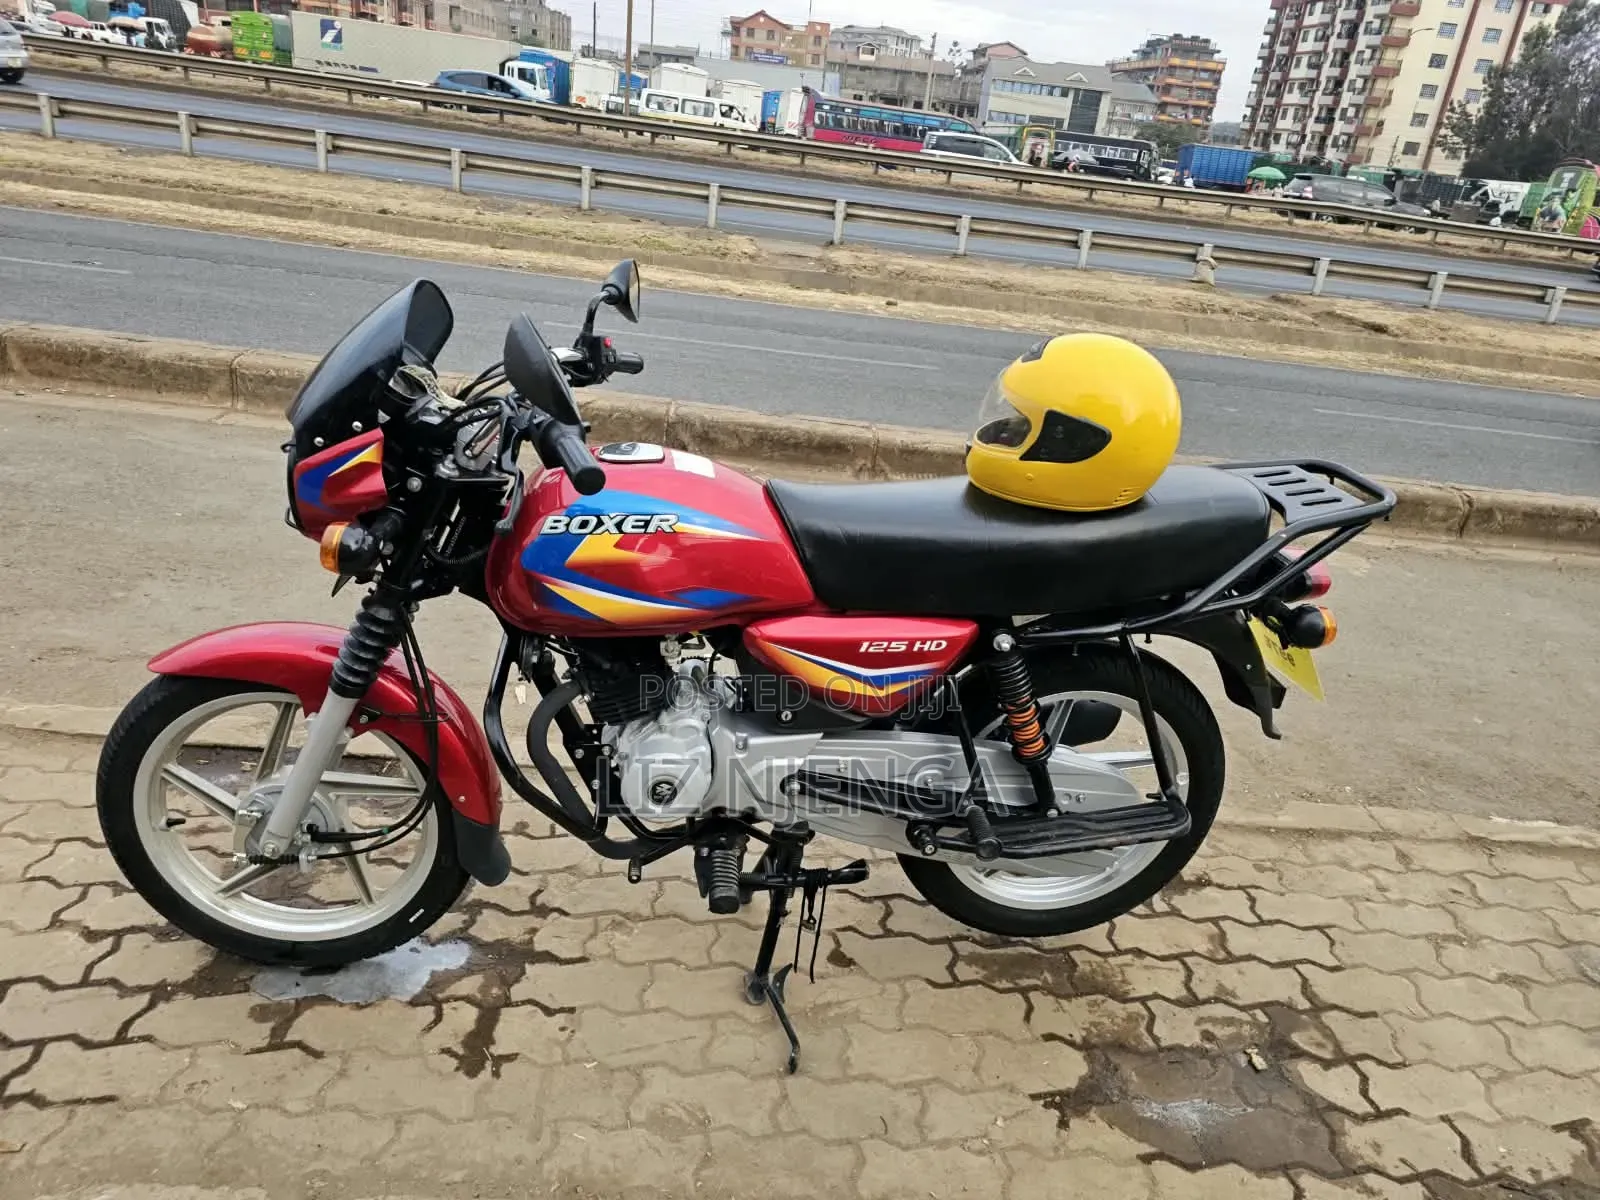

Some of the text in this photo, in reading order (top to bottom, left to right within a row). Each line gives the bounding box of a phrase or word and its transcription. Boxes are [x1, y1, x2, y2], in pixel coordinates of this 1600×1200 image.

[540, 514, 679, 536] BOXER
[859, 639, 948, 653] 125 HD
